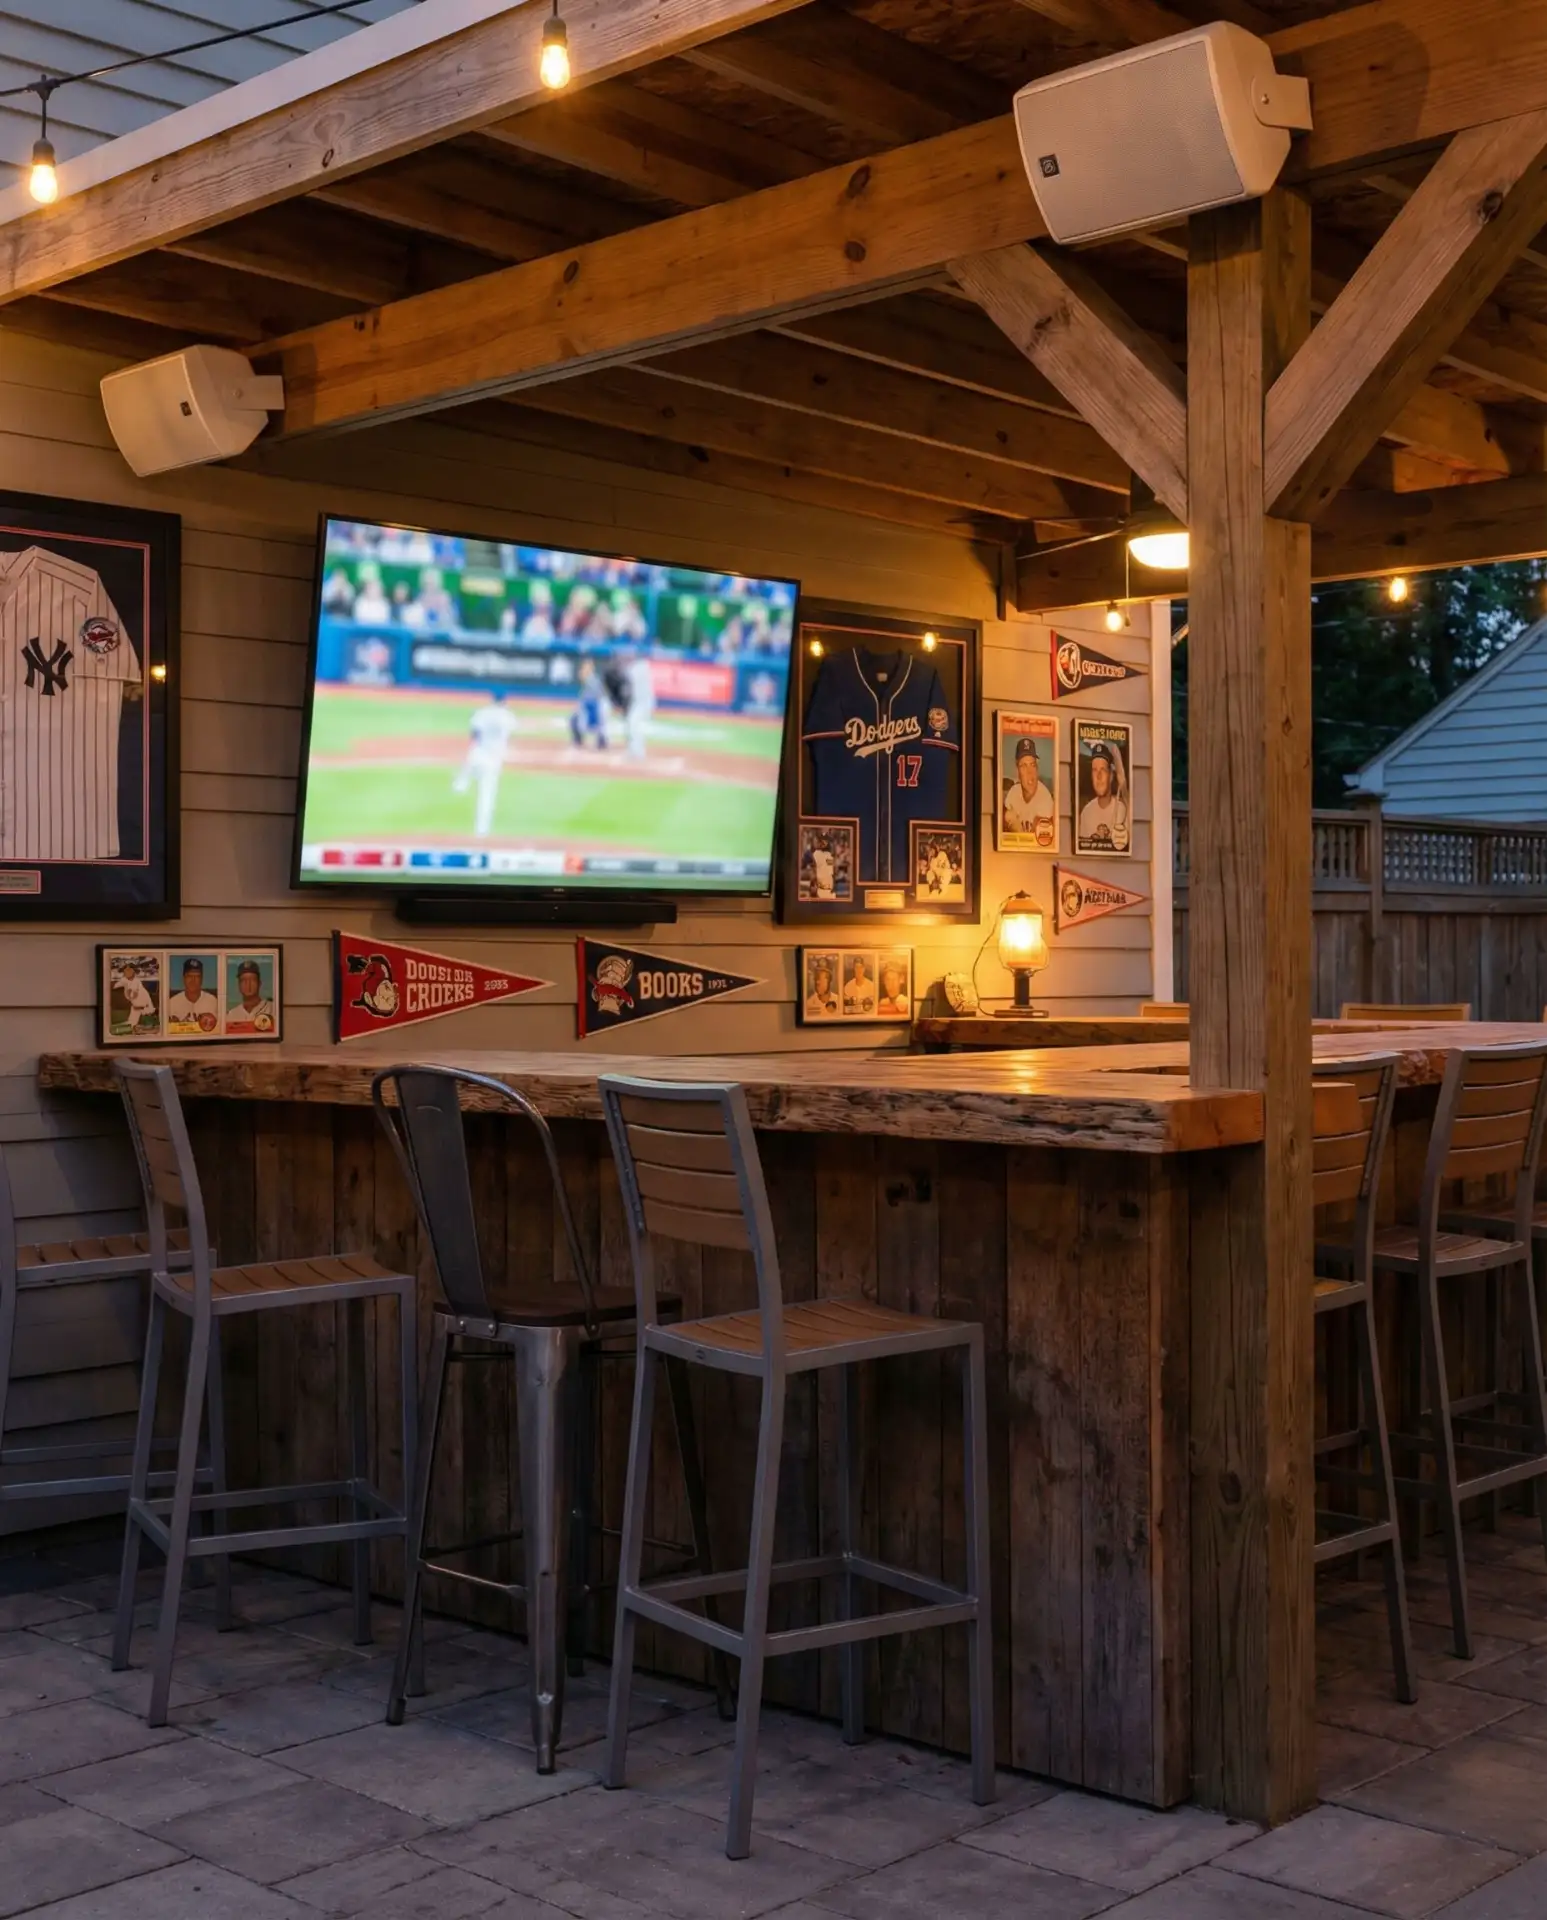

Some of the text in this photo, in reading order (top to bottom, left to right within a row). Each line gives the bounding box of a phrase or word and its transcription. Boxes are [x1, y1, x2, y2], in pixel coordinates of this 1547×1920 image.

[845, 714, 921, 757] Dodgers
[897, 755, 922, 787] 17
[638, 972, 703, 1000] BOOKS
